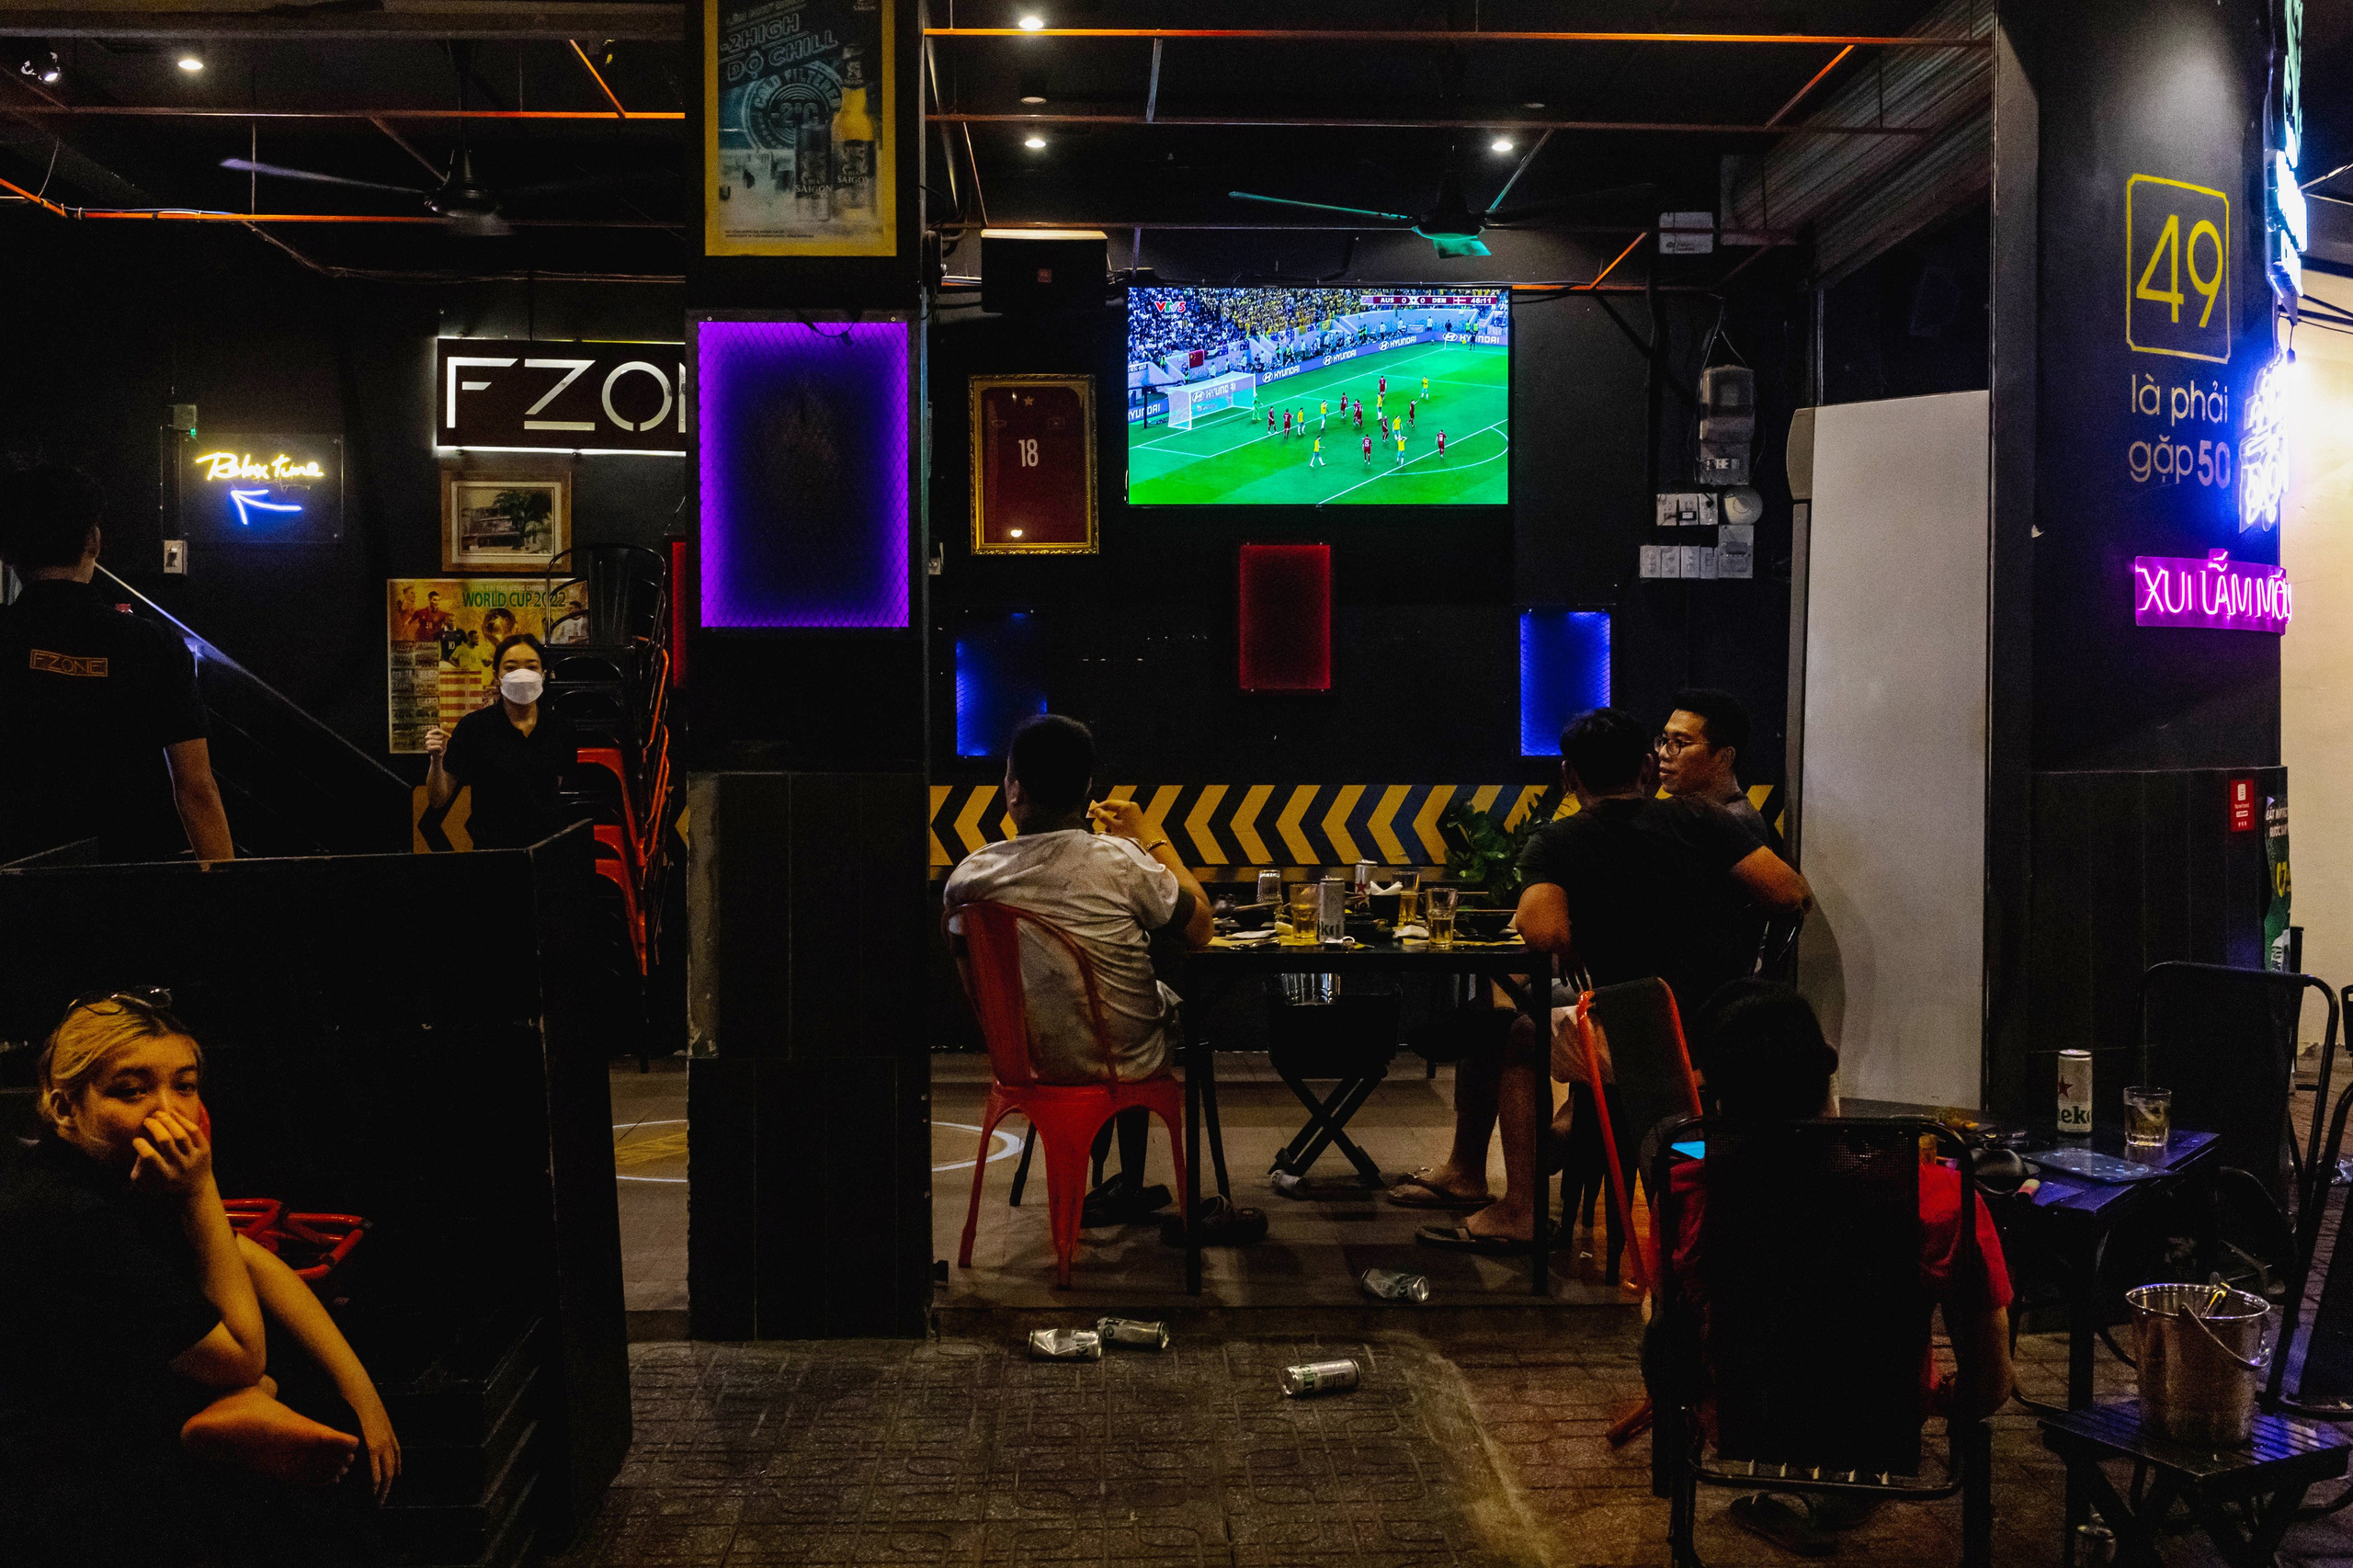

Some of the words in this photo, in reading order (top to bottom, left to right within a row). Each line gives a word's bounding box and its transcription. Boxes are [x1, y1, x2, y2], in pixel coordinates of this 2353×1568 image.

[795, 184, 833, 194] SAIGON
[2136, 214, 2223, 328] 49
[1154, 301, 1187, 313] VTV5
[1390, 335, 1417, 347] HYUNDAI
[1333, 349, 1357, 362] HYUNDAI
[1274, 365, 1301, 380] HYUNDAI
[2131, 373, 2160, 415] là
[2171, 380, 2228, 426] phải
[1018, 438, 1039, 467] 18
[2129, 434, 2193, 484] gặp
[2198, 439, 2231, 489] 50
[2136, 566, 2193, 613] XUI
[462, 591, 506, 608] WORLD
[509, 591, 532, 608] CUP
[34, 653, 105, 674] FZONE
